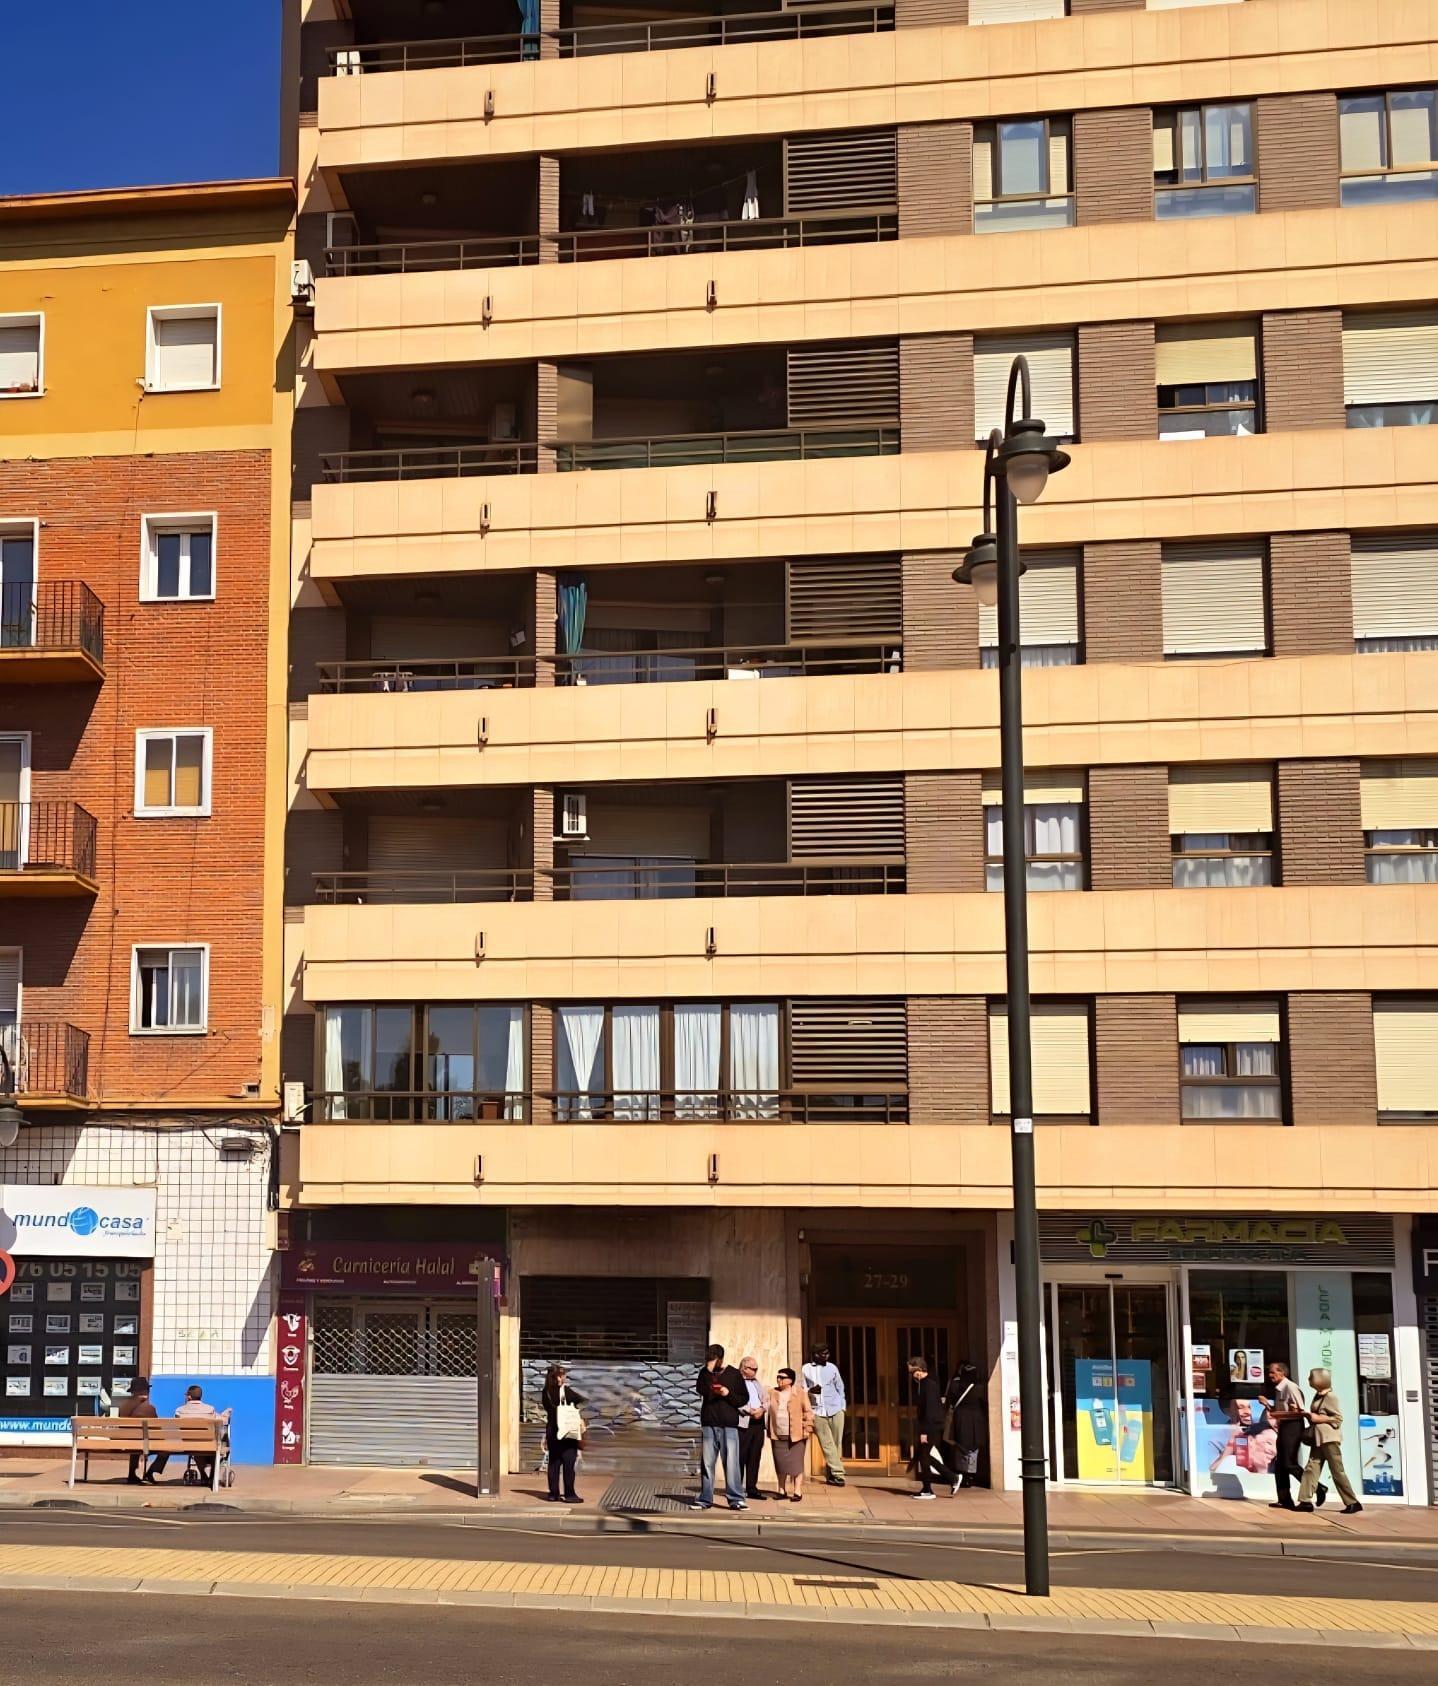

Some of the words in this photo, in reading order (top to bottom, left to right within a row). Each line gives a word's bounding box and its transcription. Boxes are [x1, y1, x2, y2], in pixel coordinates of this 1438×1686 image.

[1131, 1219, 1348, 1244] FARMACIA
[332, 1256, 410, 1274] Carnicería
[415, 1256, 455, 1276] Halal
[864, 1273, 908, 1289] 27-29
